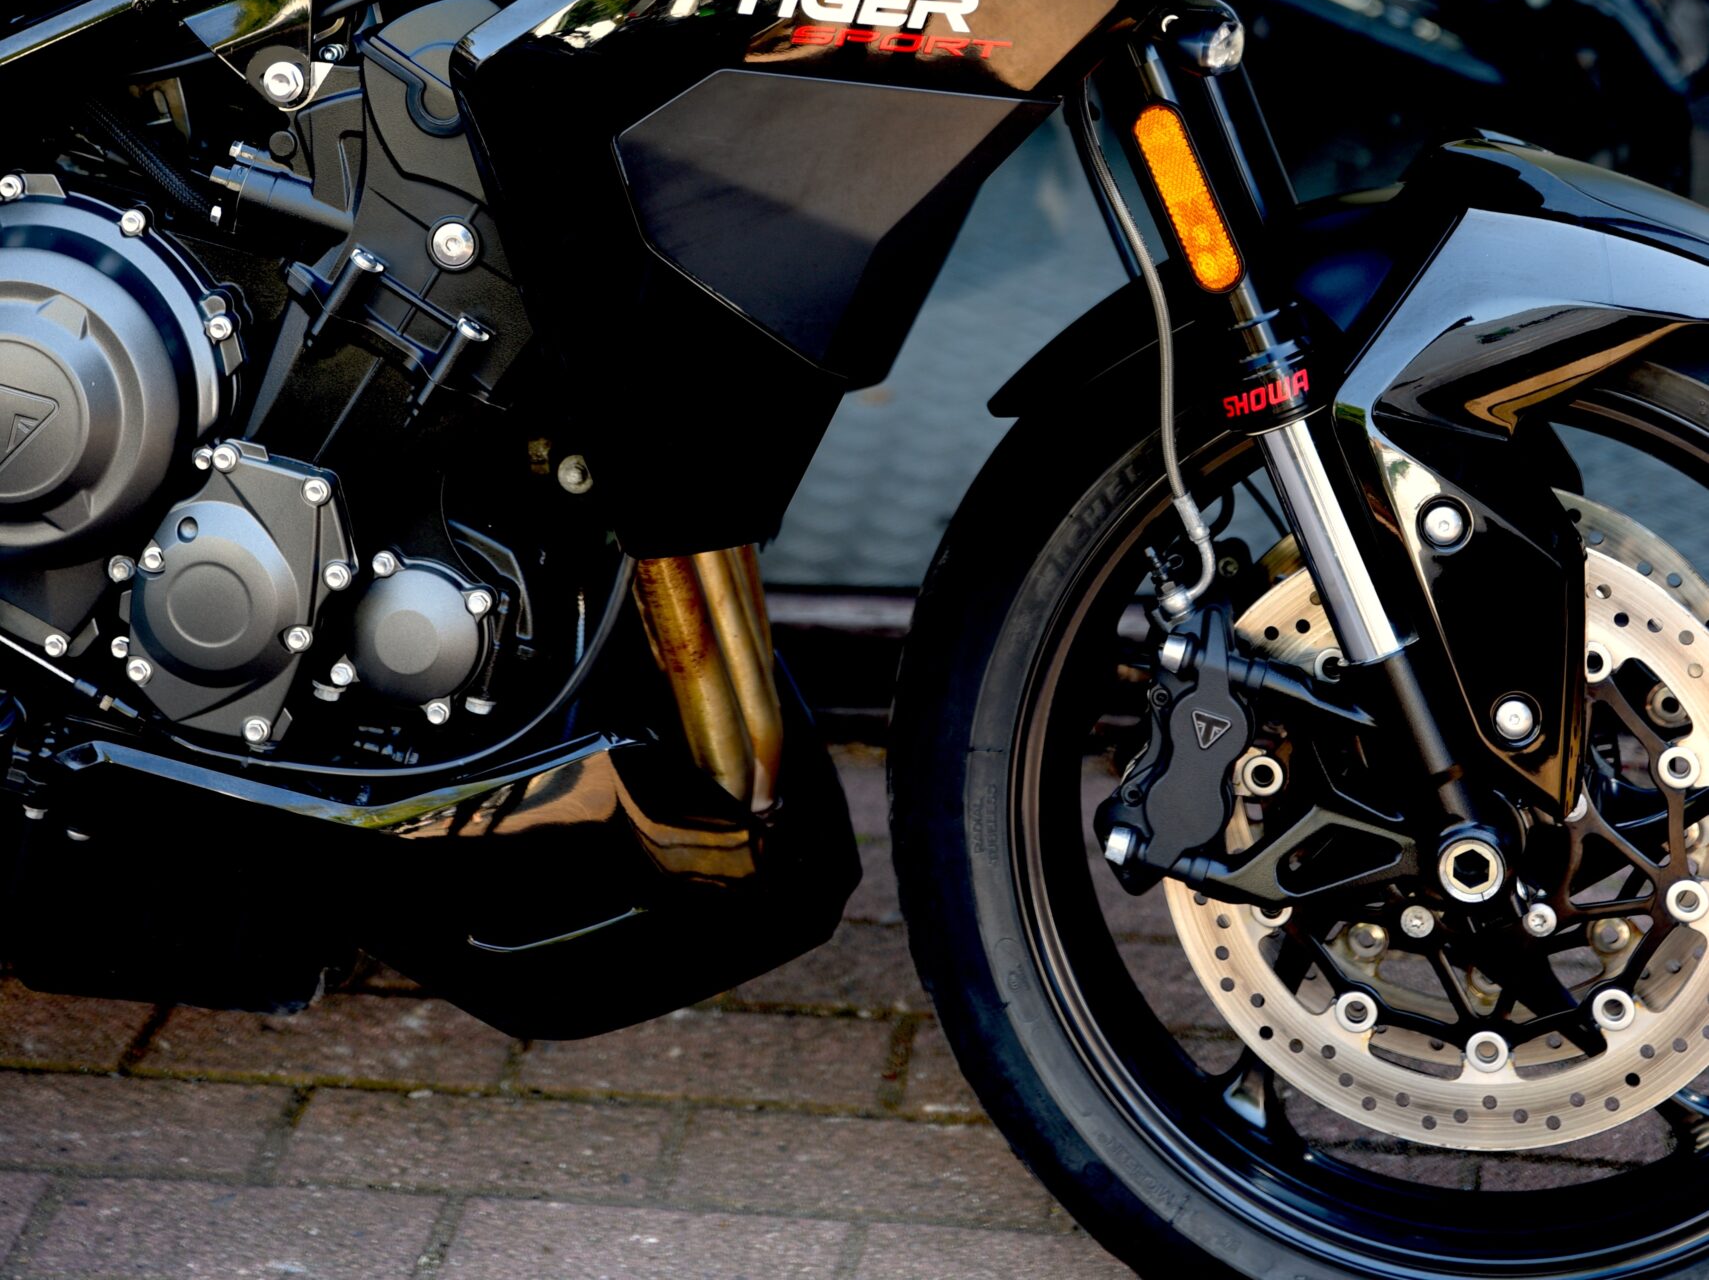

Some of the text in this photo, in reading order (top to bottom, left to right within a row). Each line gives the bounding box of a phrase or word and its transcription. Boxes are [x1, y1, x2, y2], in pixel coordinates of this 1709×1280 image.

[791, 25, 1012, 59] SPORT
[1222, 369, 1309, 418] SHOWA
[972, 796, 985, 854] RADIAL
